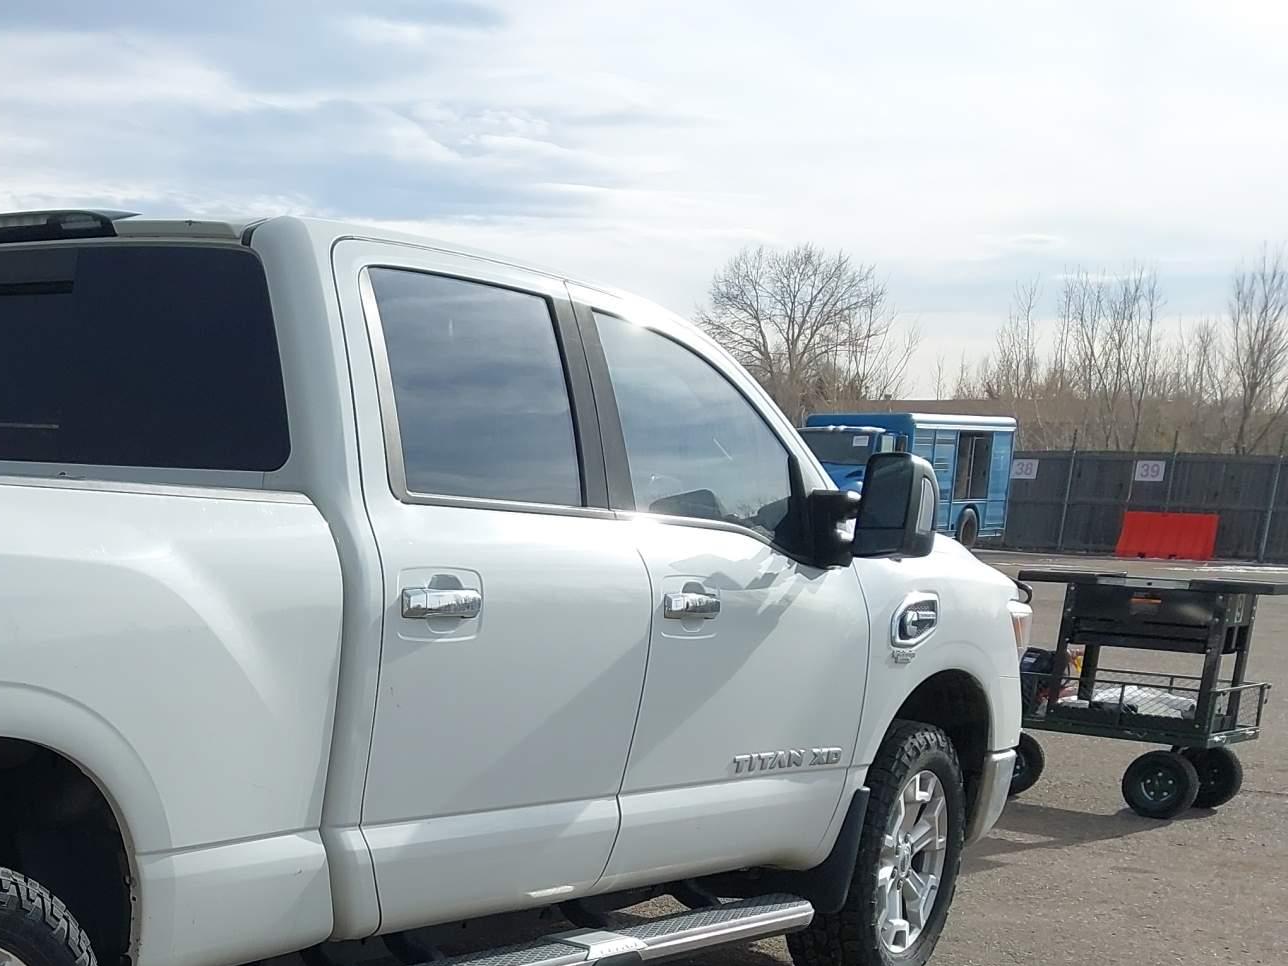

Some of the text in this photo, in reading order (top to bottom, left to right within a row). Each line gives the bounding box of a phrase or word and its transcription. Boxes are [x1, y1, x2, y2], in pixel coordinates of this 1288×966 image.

[1015, 462, 1034, 476] 38
[1140, 463, 1161, 478] 39
[733, 746, 843, 774] TITAN XD
